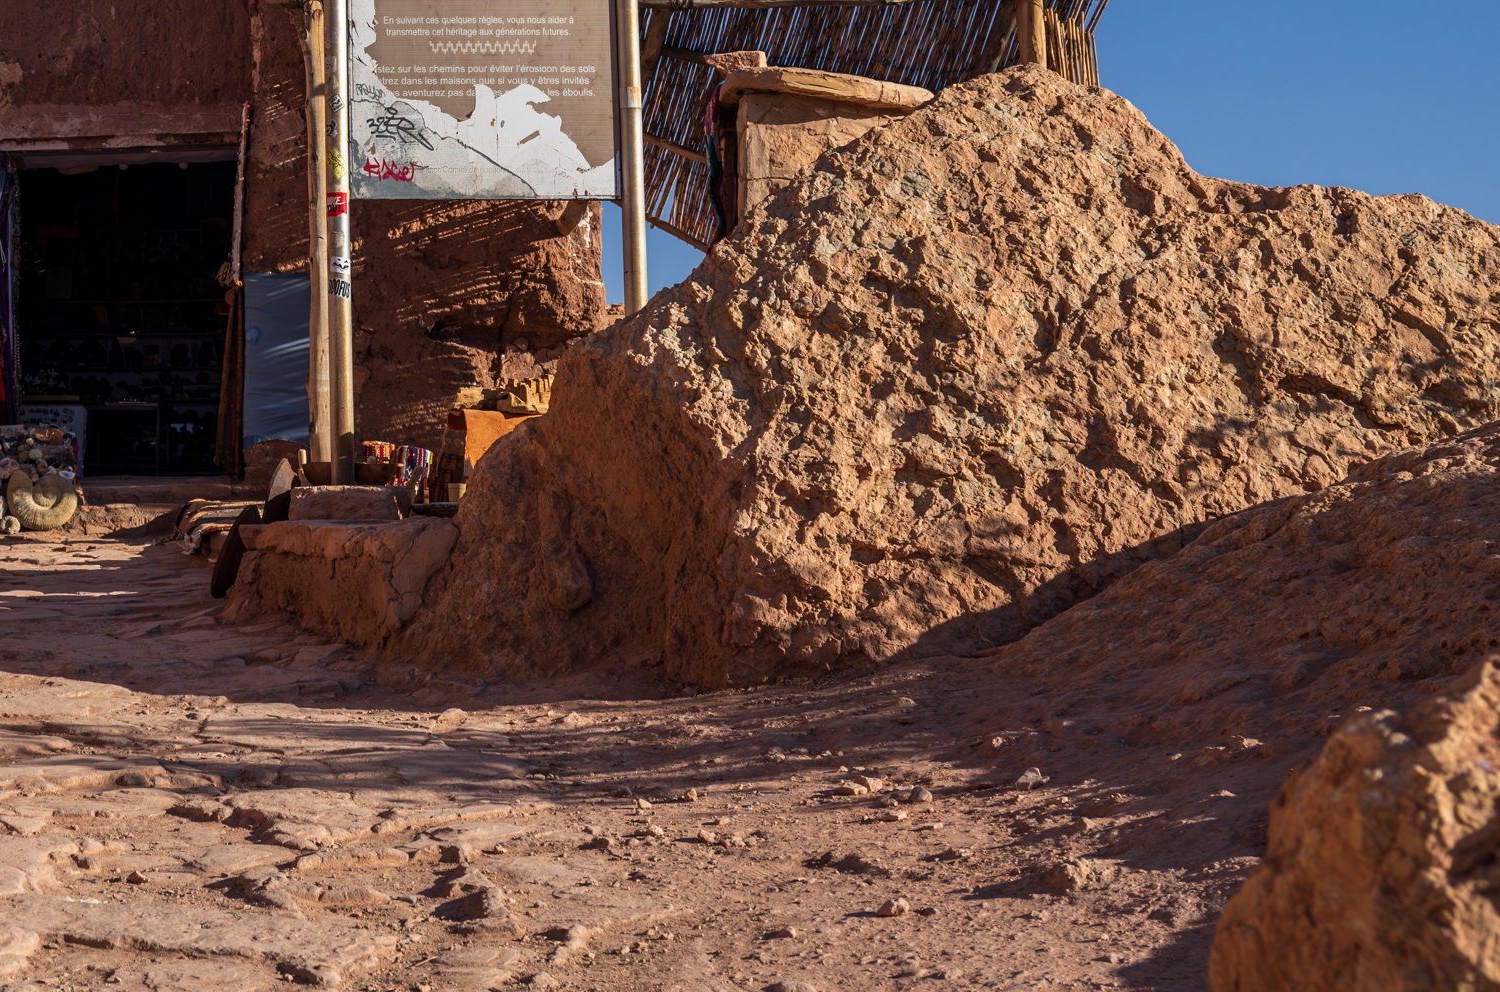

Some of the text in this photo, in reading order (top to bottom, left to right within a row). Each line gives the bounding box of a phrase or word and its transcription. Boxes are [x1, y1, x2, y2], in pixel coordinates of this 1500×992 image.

[383, 16, 394, 24] En
[396, 16, 424, 24] suivant
[441, 16, 477, 26] quelques
[479, 16, 505, 26] règles,
[506, 17, 525, 25] vous
[548, 16, 567, 24] aider
[569, 16, 574, 24] à
[386, 28, 430, 36] transmettre
[432, 28, 444, 36] cet
[446, 28, 477, 37] héritage
[495, 28, 541, 37] générations
[542, 27, 571, 36] futures.
[377, 65, 395, 73] stez
[413, 65, 426, 73] les
[429, 65, 466, 73] chemins
[467, 66, 487, 74] pour
[489, 64, 514, 73] éviter
[515, 64, 558, 73] l'érosioon
[560, 64, 576, 73] des
[578, 64, 596, 73] sols
[401, 77, 422, 85] dans
[424, 77, 438, 85] les
[440, 77, 477, 85] maisons
[497, 77, 505, 85] si
[530, 78, 536, 86] y
[537, 76, 560, 85] êtres
[562, 76, 590, 85] invités
[402, 89, 446, 97] aventurez
[447, 90, 464, 99] pas
[466, 89, 476, 97] da
[547, 88, 560, 97] les
[562, 88, 596, 97] éboulis.
